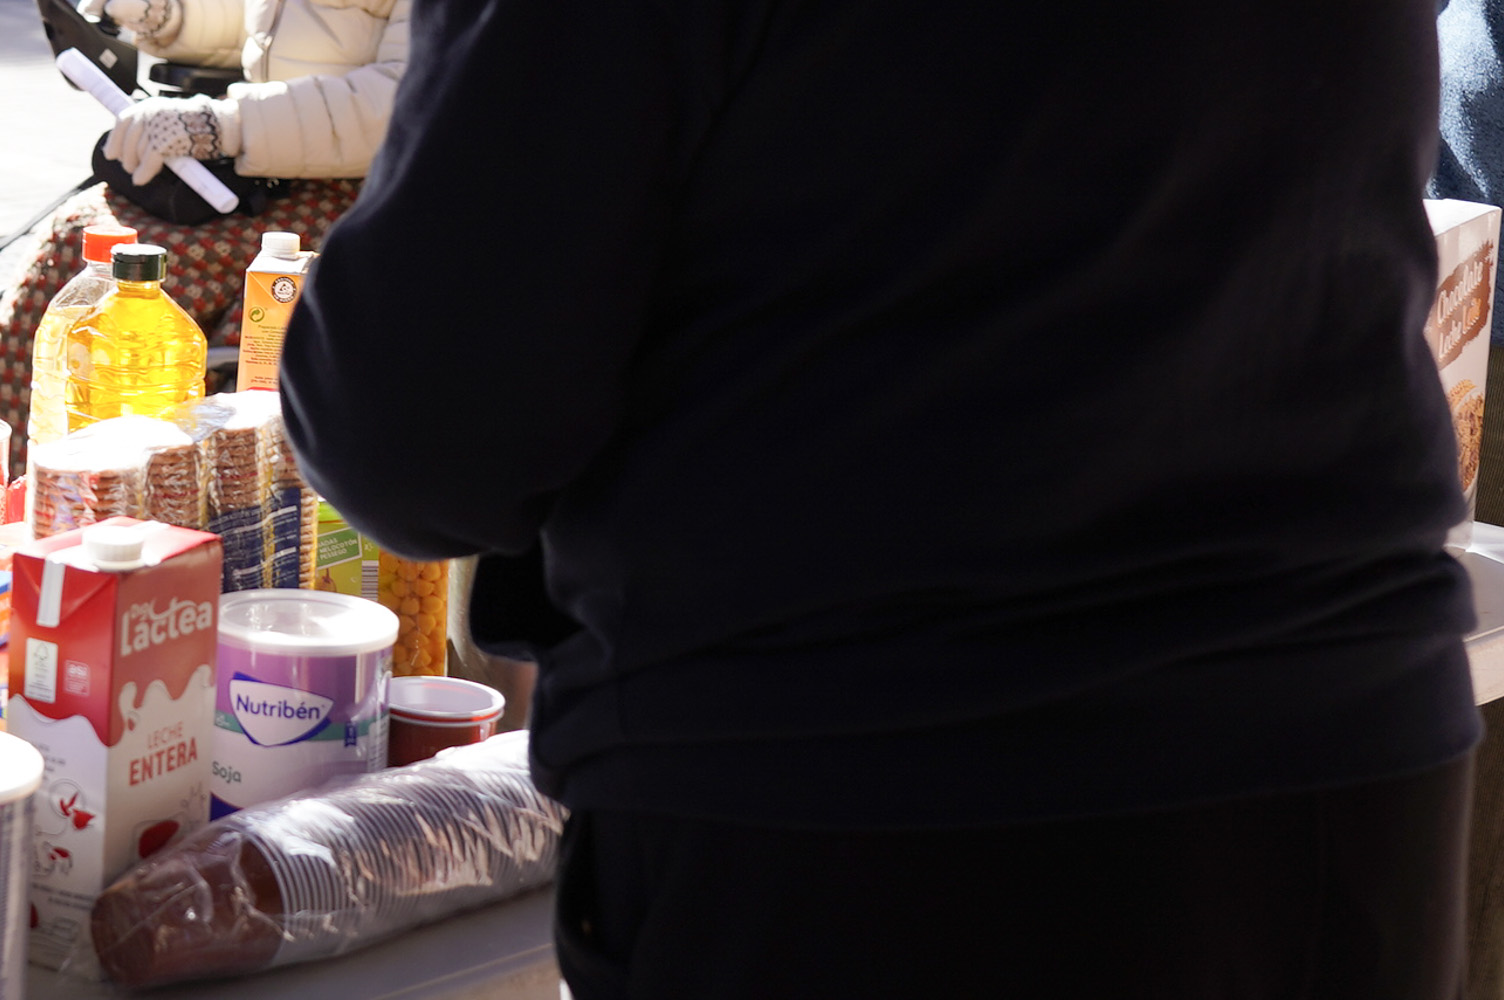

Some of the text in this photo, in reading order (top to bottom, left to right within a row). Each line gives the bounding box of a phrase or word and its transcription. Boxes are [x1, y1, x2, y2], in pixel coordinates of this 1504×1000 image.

[236, 693, 321, 720] Nutribén
[148, 720, 183, 749] LECHE
[129, 736, 198, 787] ENTERA
[212, 760, 242, 784] Soja
